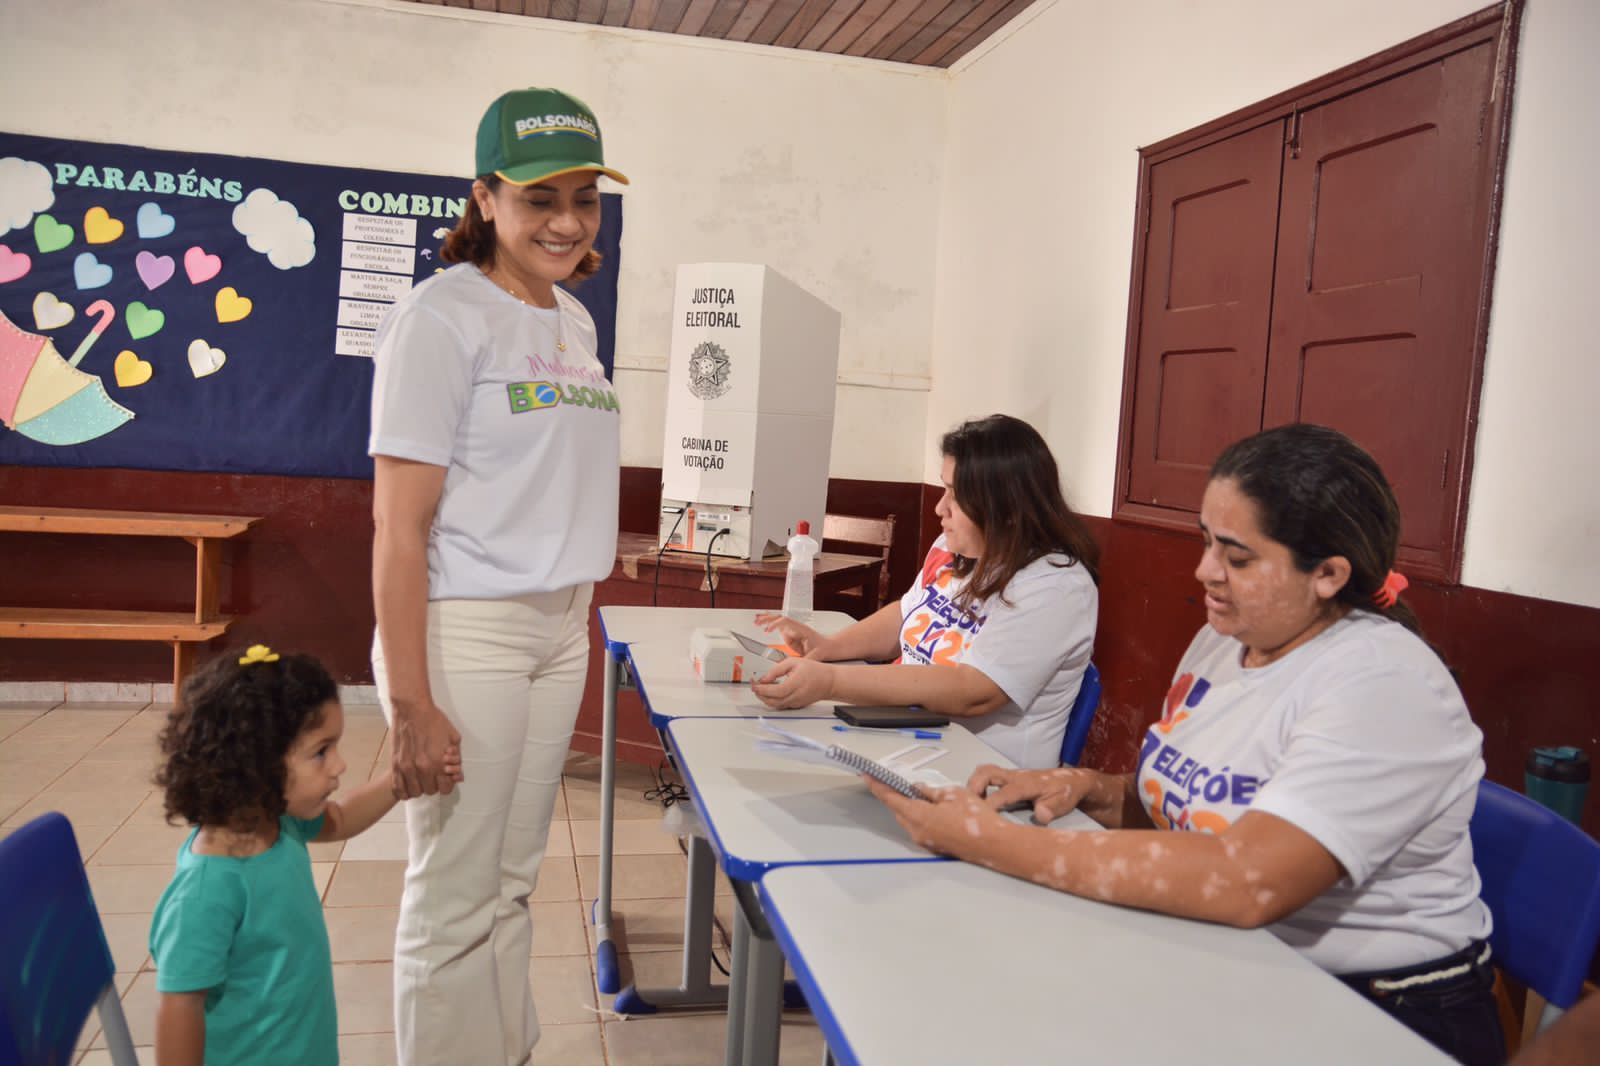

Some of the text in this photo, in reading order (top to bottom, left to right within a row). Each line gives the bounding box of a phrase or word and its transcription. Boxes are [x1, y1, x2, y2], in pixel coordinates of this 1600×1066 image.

[54, 163, 243, 202] PARABÉNS
[338, 190, 468, 218] COMBIN
[692, 287, 735, 308] JUSTIÇA
[685, 311, 741, 328] ELEITORAL
[507, 380, 620, 414] BOLSONA
[682, 437, 729, 453] CABINA DE
[683, 454, 724, 471] VOTAÇÃO
[1152, 744, 1268, 806] ELEIÇÕE
